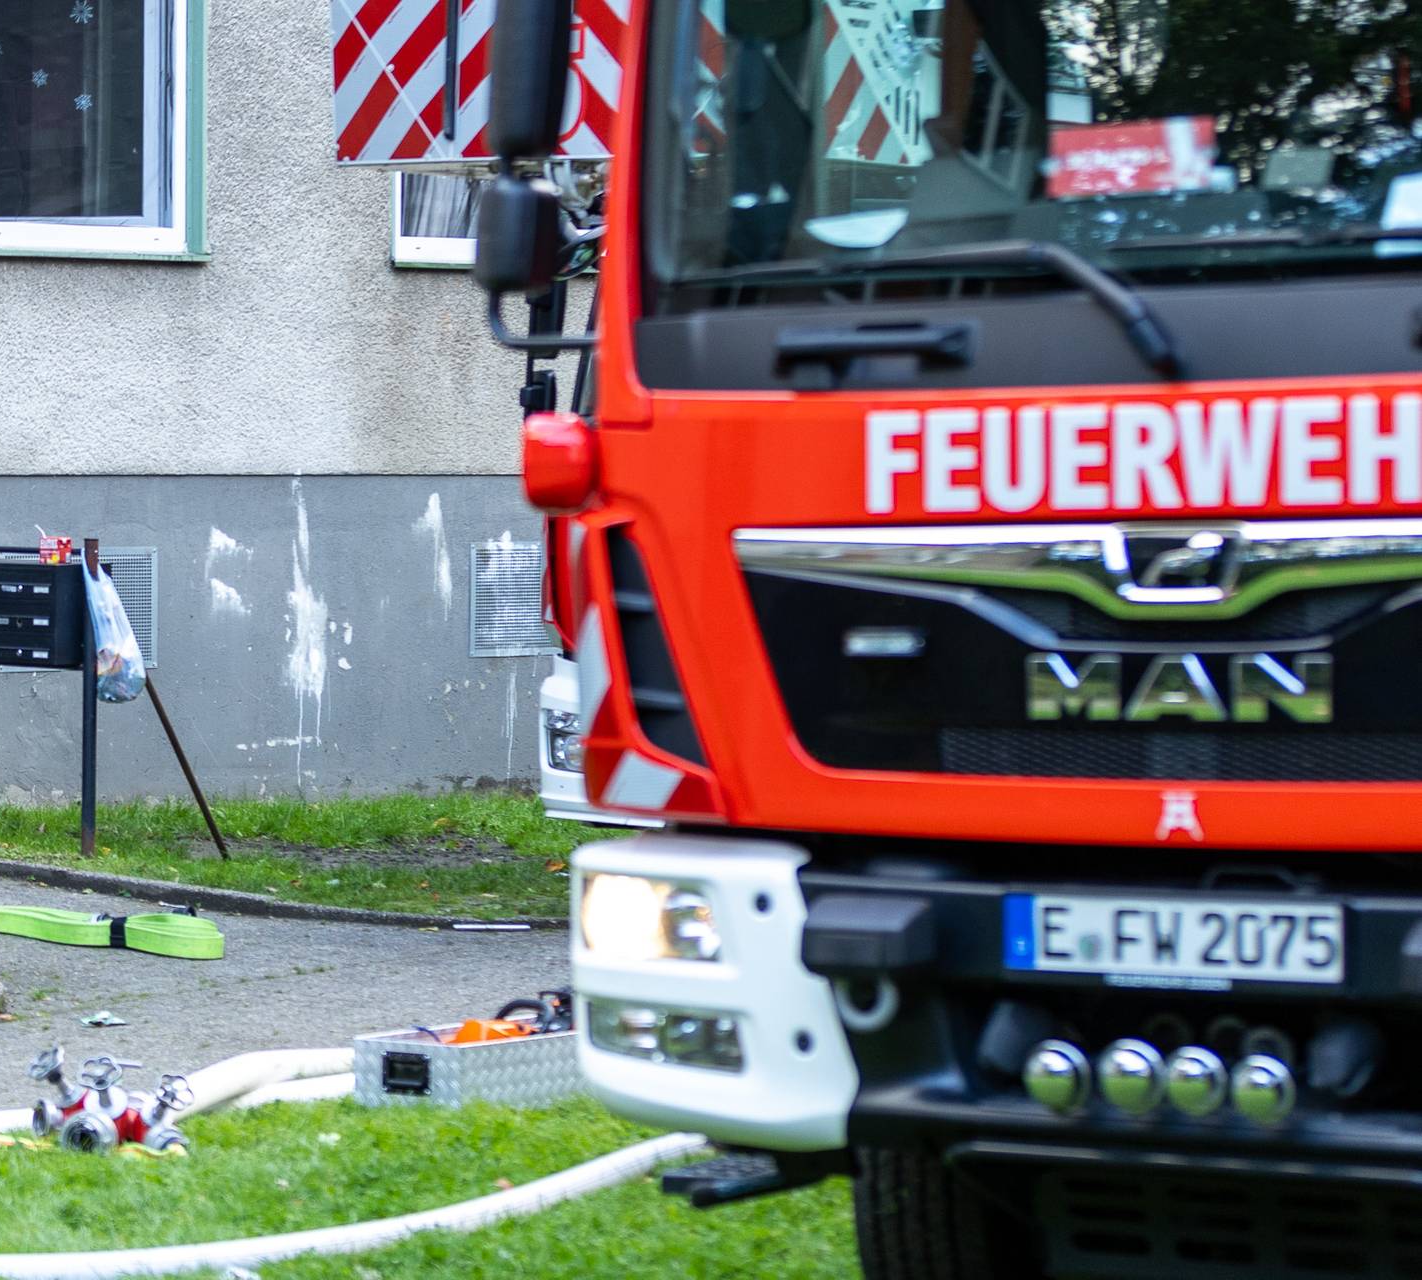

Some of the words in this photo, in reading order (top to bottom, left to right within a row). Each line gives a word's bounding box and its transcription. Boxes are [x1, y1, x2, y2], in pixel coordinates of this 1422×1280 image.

[865, 393, 1422, 514] FEUERWEH
[1025, 652, 1333, 723] MAN
[1042, 906, 1072, 959] E
[1112, 909, 1182, 964] FW
[1201, 912, 1337, 969] 2075
